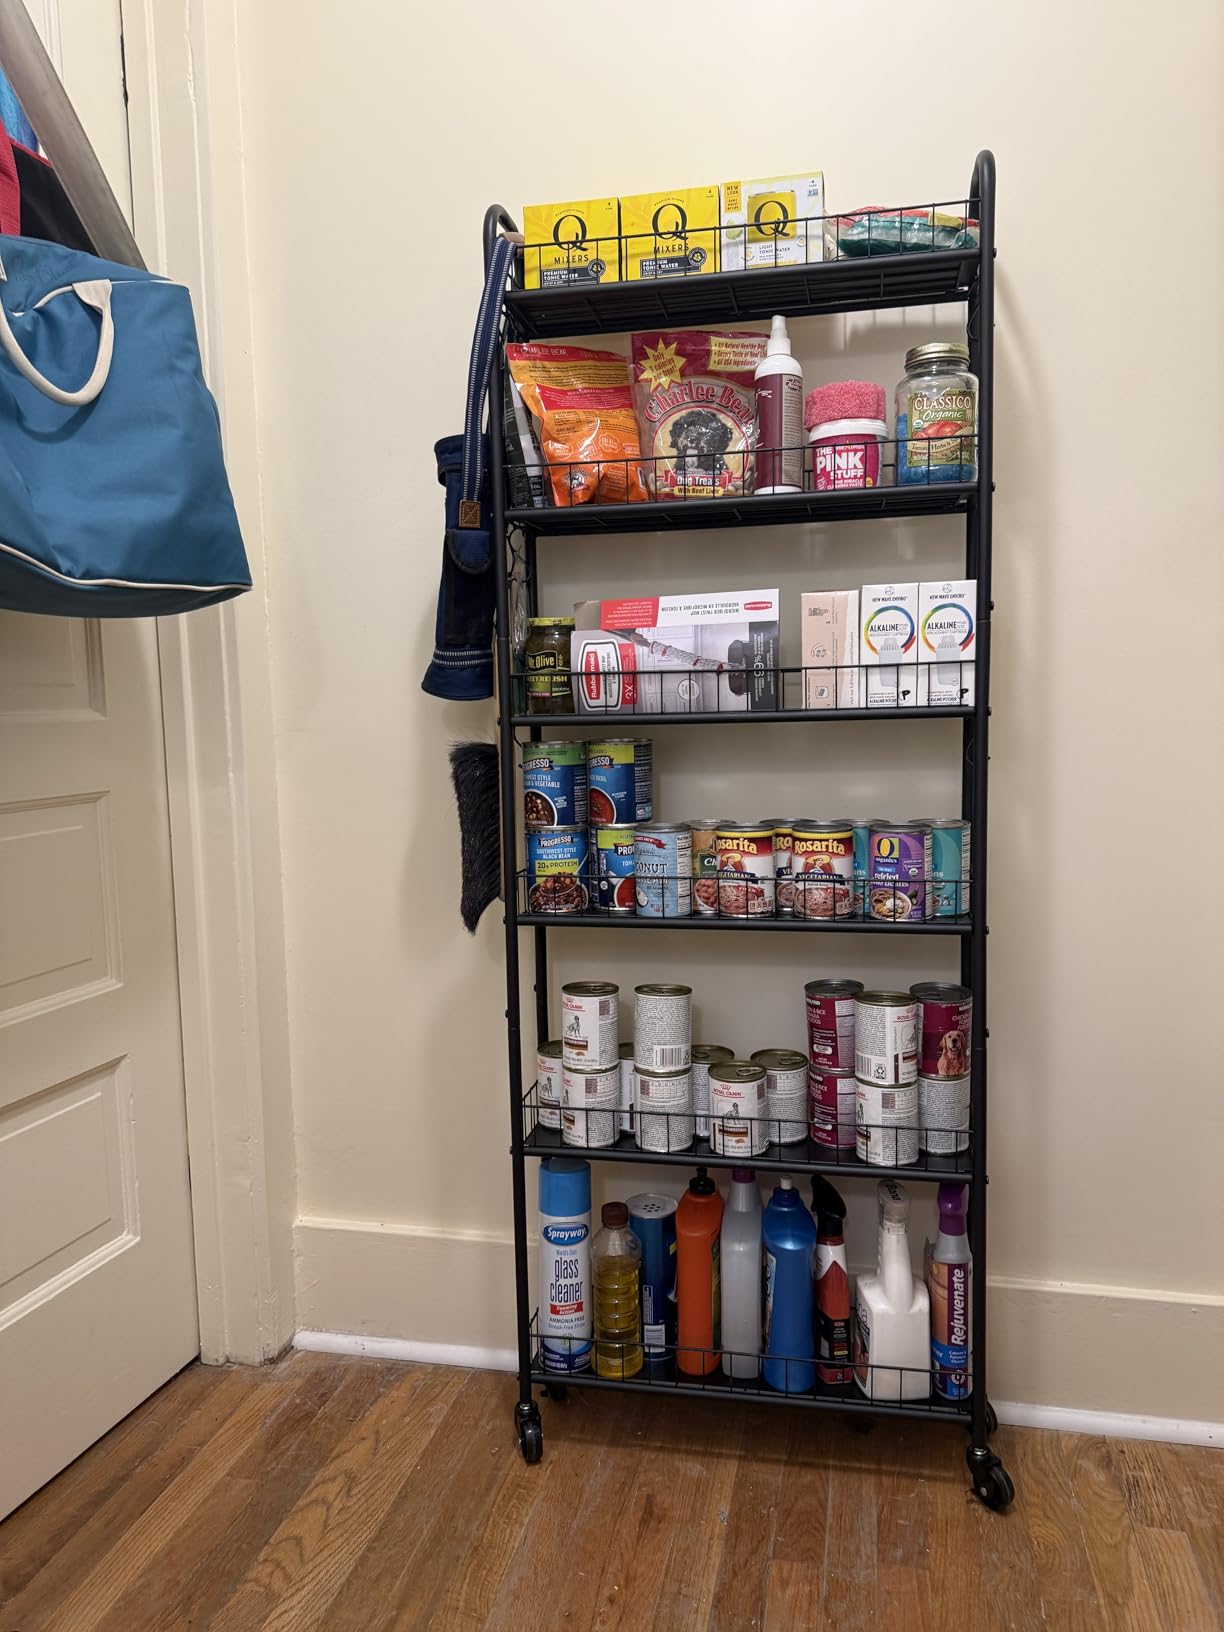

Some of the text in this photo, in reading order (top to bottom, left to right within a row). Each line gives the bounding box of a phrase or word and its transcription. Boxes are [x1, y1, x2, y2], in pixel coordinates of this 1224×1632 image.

[652, 203, 688, 240] Q
[754, 200, 790, 237] Q
[553, 214, 588, 251] Q
[653, 243, 689, 254] MIXERS
[554, 254, 589, 264] MIXERS
[740, 342, 756, 350] Healthy
[757, 343, 766, 351] Dog
[652, 351, 665, 361] Only
[655, 358, 675, 370] calories
[733, 359, 756, 367] Ingredients
[644, 380, 716, 422] Charlee
[718, 384, 755, 425] Bear
[914, 396, 971, 410] CLASSICO
[923, 409, 964, 421] Organic
[816, 448, 832, 456] THE
[816, 452, 863, 474] PINK
[830, 469, 864, 480] STUFF
[677, 476, 720, 487] Dog Treas
[869, 624, 899, 632] ALKALINE
[927, 622, 957, 630] ALKALINE
[588, 653, 597, 698] Rubbemaid
[624, 684, 634, 699] 3X
[902, 690, 911, 700] P
[960, 688, 969, 699] P
[524, 759, 550, 771] OGRESSO
[540, 836, 571, 847] PROGRESSO
[794, 839, 845, 855] Rosarita
[877, 837, 894, 858] O
[550, 860, 578, 868] PROTEIN
[636, 863, 667, 873] CONUT
[718, 871, 751, 879] EGETARIAN
[547, 1226, 587, 1243] Sprayway
[555, 1256, 579, 1283] glass
[550, 1280, 583, 1303] cleaner
[951, 1268, 966, 1345] Rejuvenate
